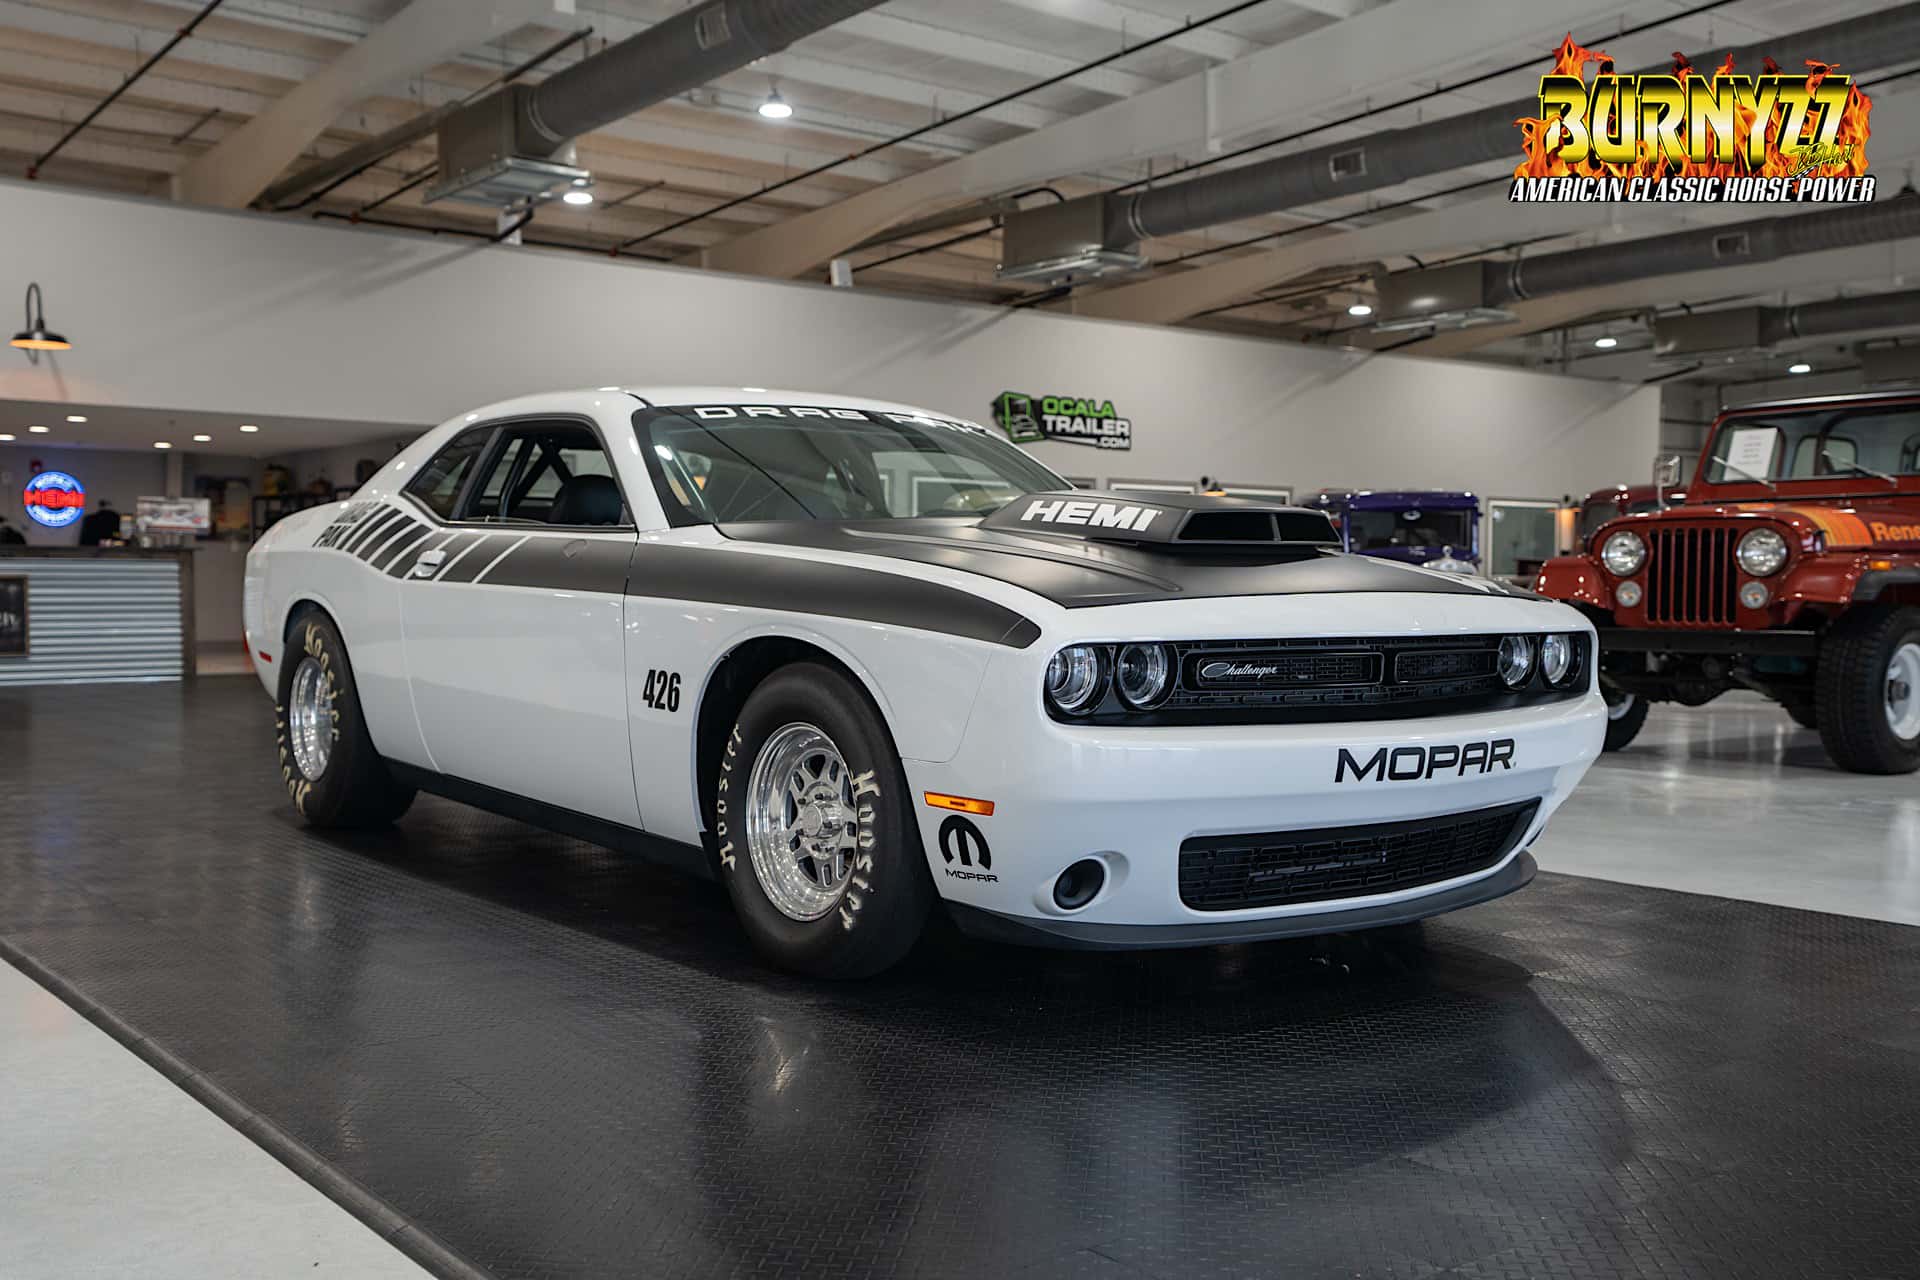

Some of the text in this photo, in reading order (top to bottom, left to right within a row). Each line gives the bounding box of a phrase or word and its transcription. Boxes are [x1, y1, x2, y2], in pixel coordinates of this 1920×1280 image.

[694, 406, 870, 421] DRAG
[1042, 396, 1115, 417] OCALA
[1042, 415, 1130, 436] TRAILER
[1098, 436, 1131, 449] .COM
[1020, 500, 1160, 532] HEMI
[1201, 662, 1278, 679] Challenger
[642, 669, 681, 713] 426
[1334, 738, 1516, 783] MOPAR
[944, 868, 999, 883] MOPAR
